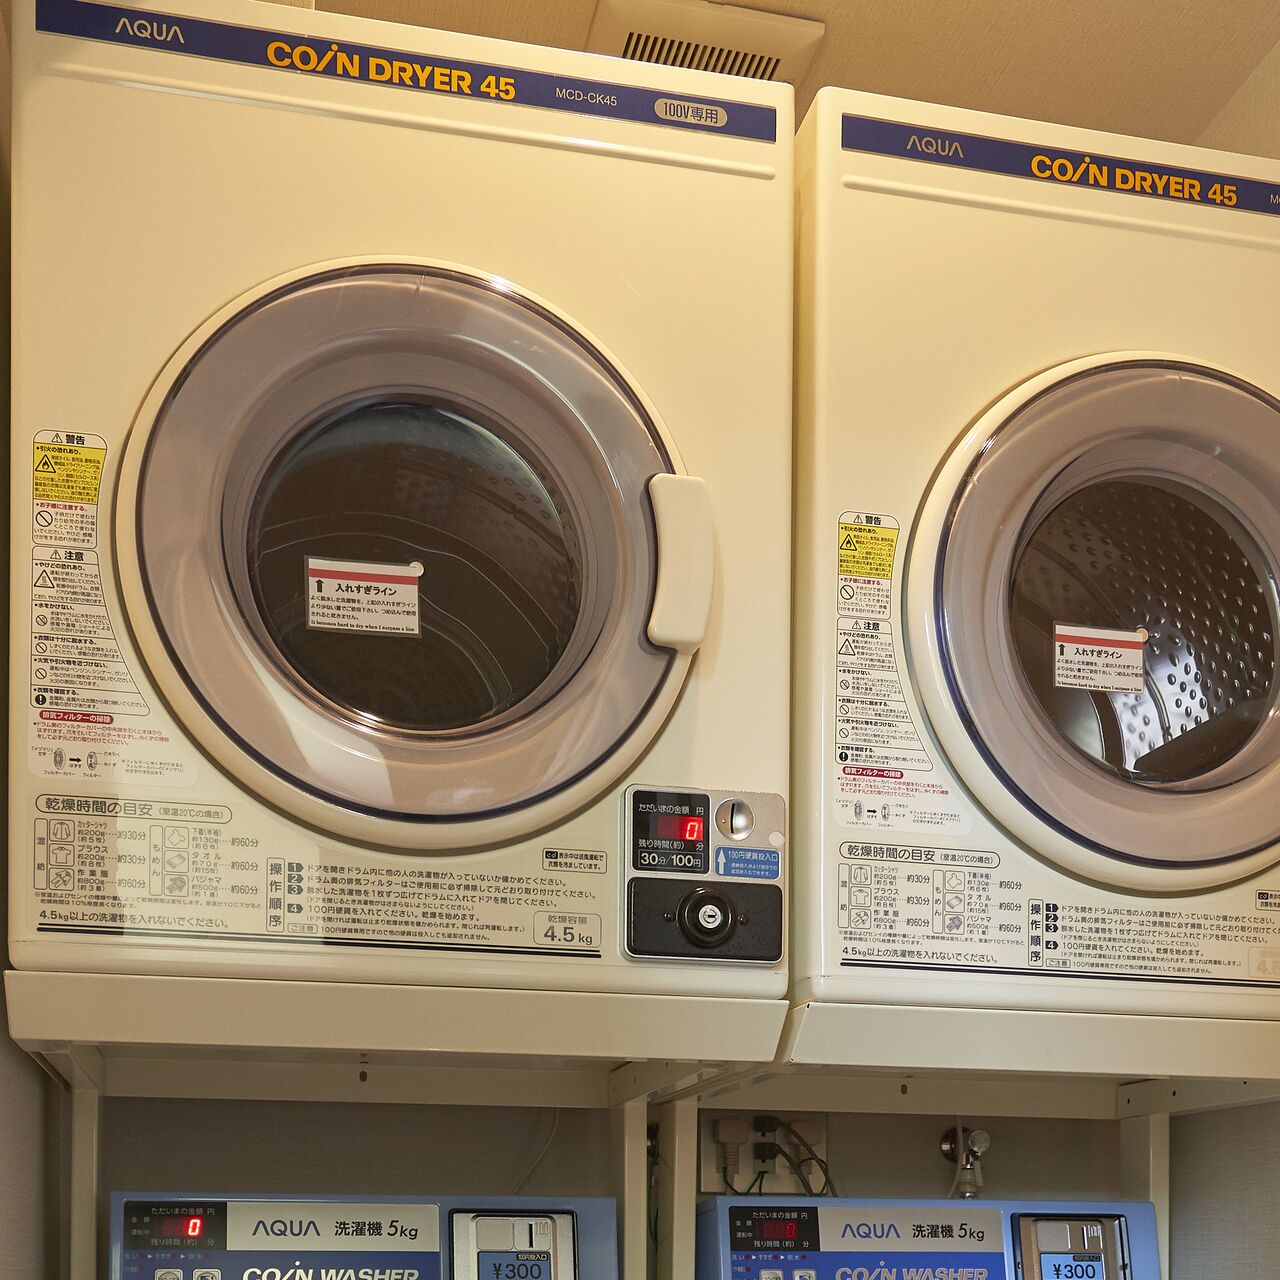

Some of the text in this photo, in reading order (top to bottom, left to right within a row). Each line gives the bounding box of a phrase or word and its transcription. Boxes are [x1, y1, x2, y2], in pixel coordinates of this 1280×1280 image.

[115, 17, 185, 44] AQUA
[265, 42, 516, 100] COIN DRYER 45
[554, 86, 618, 108] MCD-CK45
[661, 100, 719, 125] 100V専用
[906, 135, 964, 159] AQUA
[1031, 155, 1238, 206] COIN DRYER 45
[65, 433, 85, 446] 警告
[865, 515, 882, 526] 警告
[64, 550, 84, 562] 注意
[335, 583, 397, 596] 入れすぎライン
[863, 621, 880, 631] 注意
[1074, 647, 1123, 659] 入れすぎライン
[45, 797, 153, 817] 乾燥時間の目安
[638, 803, 704, 815] ただいまの金額 円
[685, 821, 698, 840] 0
[231, 837, 259, 848] 約60分
[696, 842, 704, 851] 分
[641, 853, 701, 868] 30分/100円
[847, 844, 936, 862] 乾燥時間の目安
[906, 874, 931, 883] 約30分
[999, 880, 1022, 890] 約60分
[268, 862, 283, 928] 操作順序
[547, 915, 588, 925] 乾燥容量
[543, 926, 593, 945] 4.5 kg
[1030, 903, 1041, 962] 操作順序
[207, 1208, 215, 1216] 円
[187, 1218, 201, 1236] 0
[252, 1219, 418, 1240] AQUA 洗濯機 5kg
[785, 1222, 797, 1238] 0
[841, 1223, 985, 1242] AQUA 洗濯機 5kg
[492, 1263, 542, 1280] ¥300
[1053, 1263, 1096, 1279] ¥300
